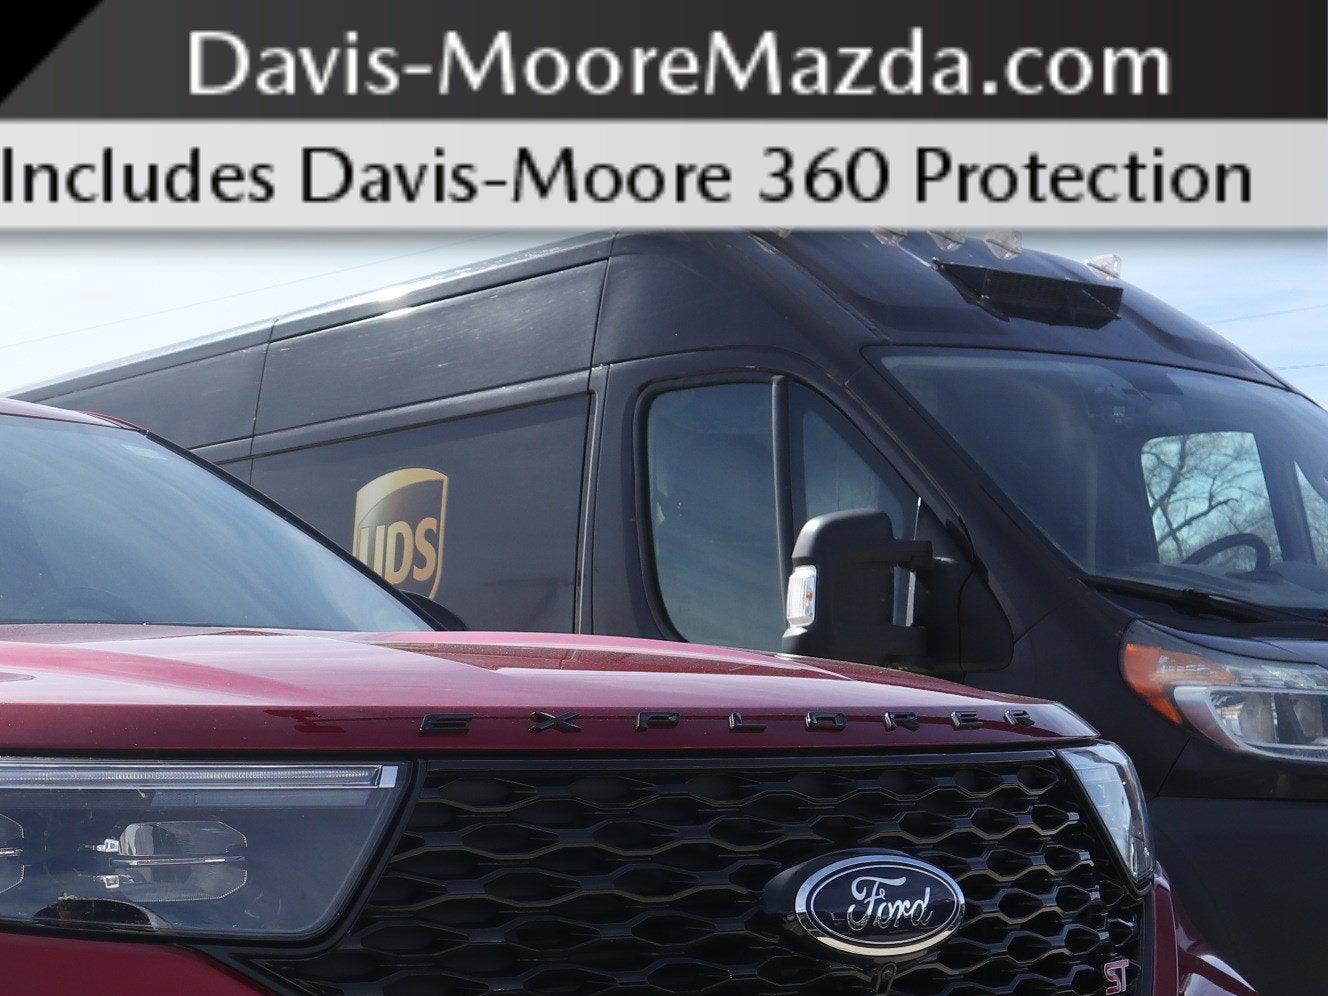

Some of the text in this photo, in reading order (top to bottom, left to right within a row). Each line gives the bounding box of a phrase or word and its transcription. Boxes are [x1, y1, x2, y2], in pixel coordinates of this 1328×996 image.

[418, 708, 1034, 734] EXPLORER
[847, 876, 933, 931] Ford
[1103, 958, 1130, 996] ST
